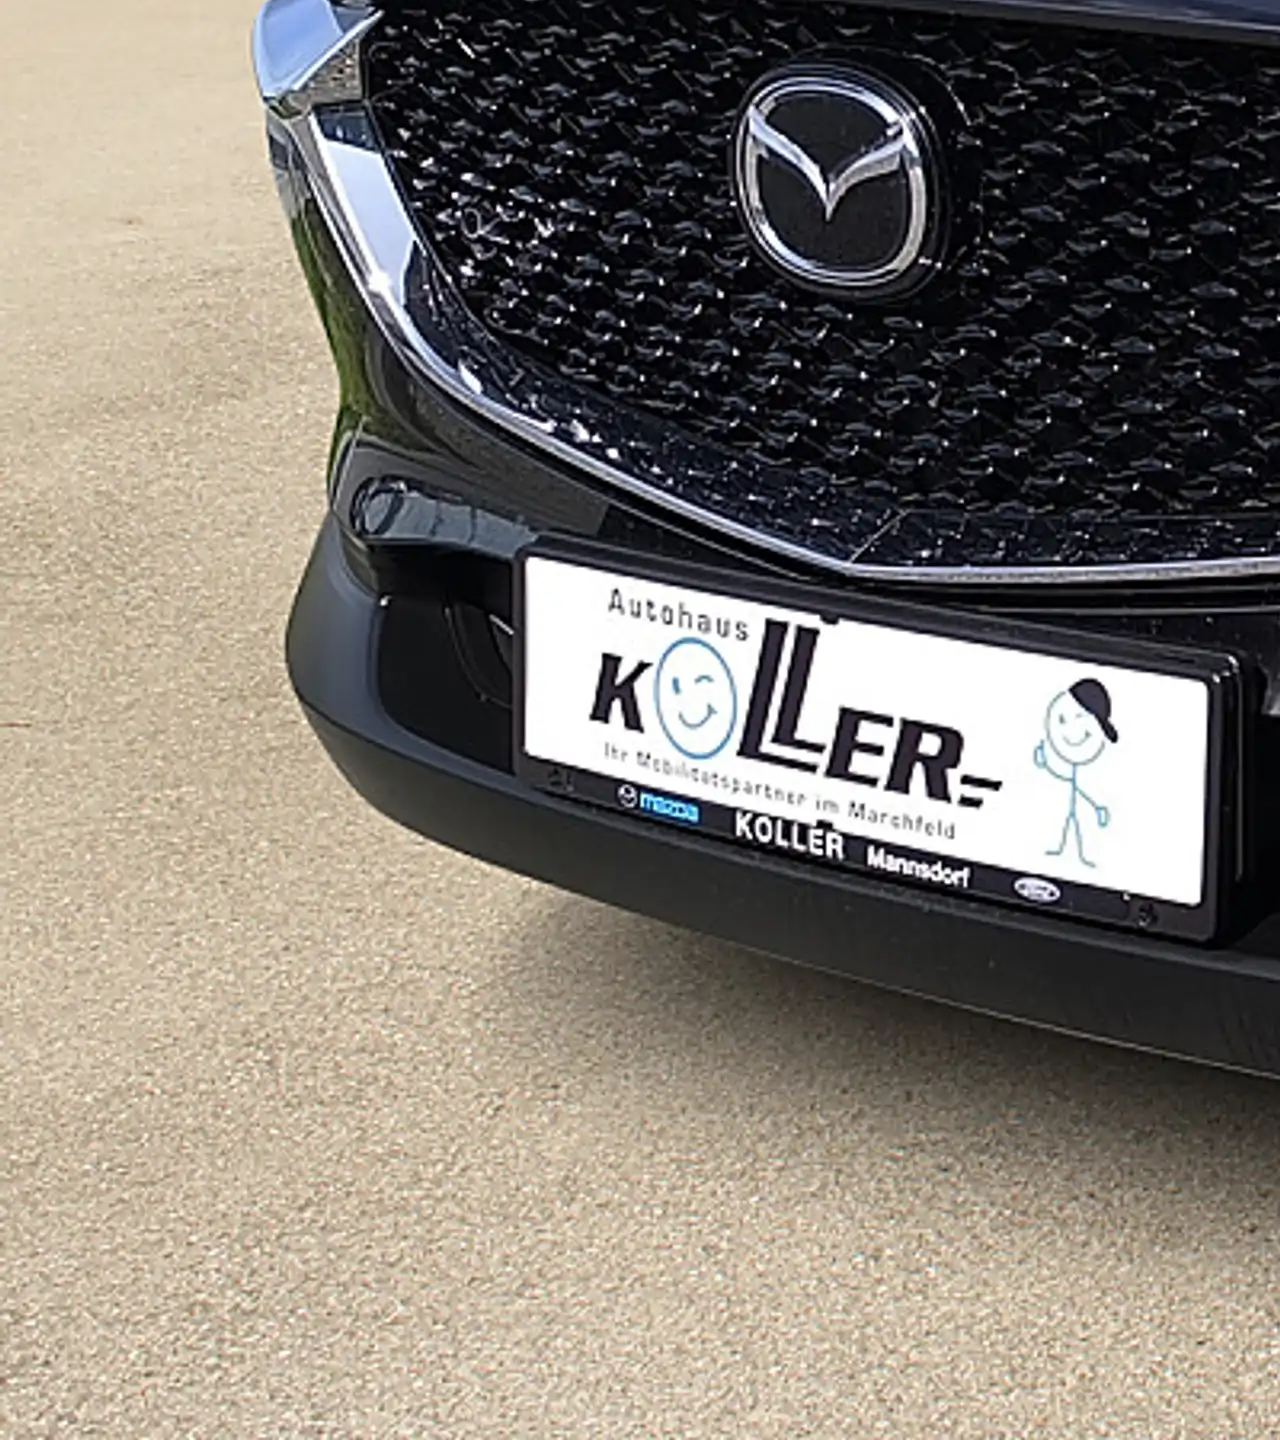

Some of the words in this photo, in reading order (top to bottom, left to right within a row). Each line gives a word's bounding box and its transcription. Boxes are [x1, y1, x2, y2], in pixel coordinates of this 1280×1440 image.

[608, 588, 749, 642] Autohaus
[848, 800, 957, 841] Marchfeld
[735, 810, 845, 861] KOLLER
[867, 844, 971, 889] Mannsdorf
